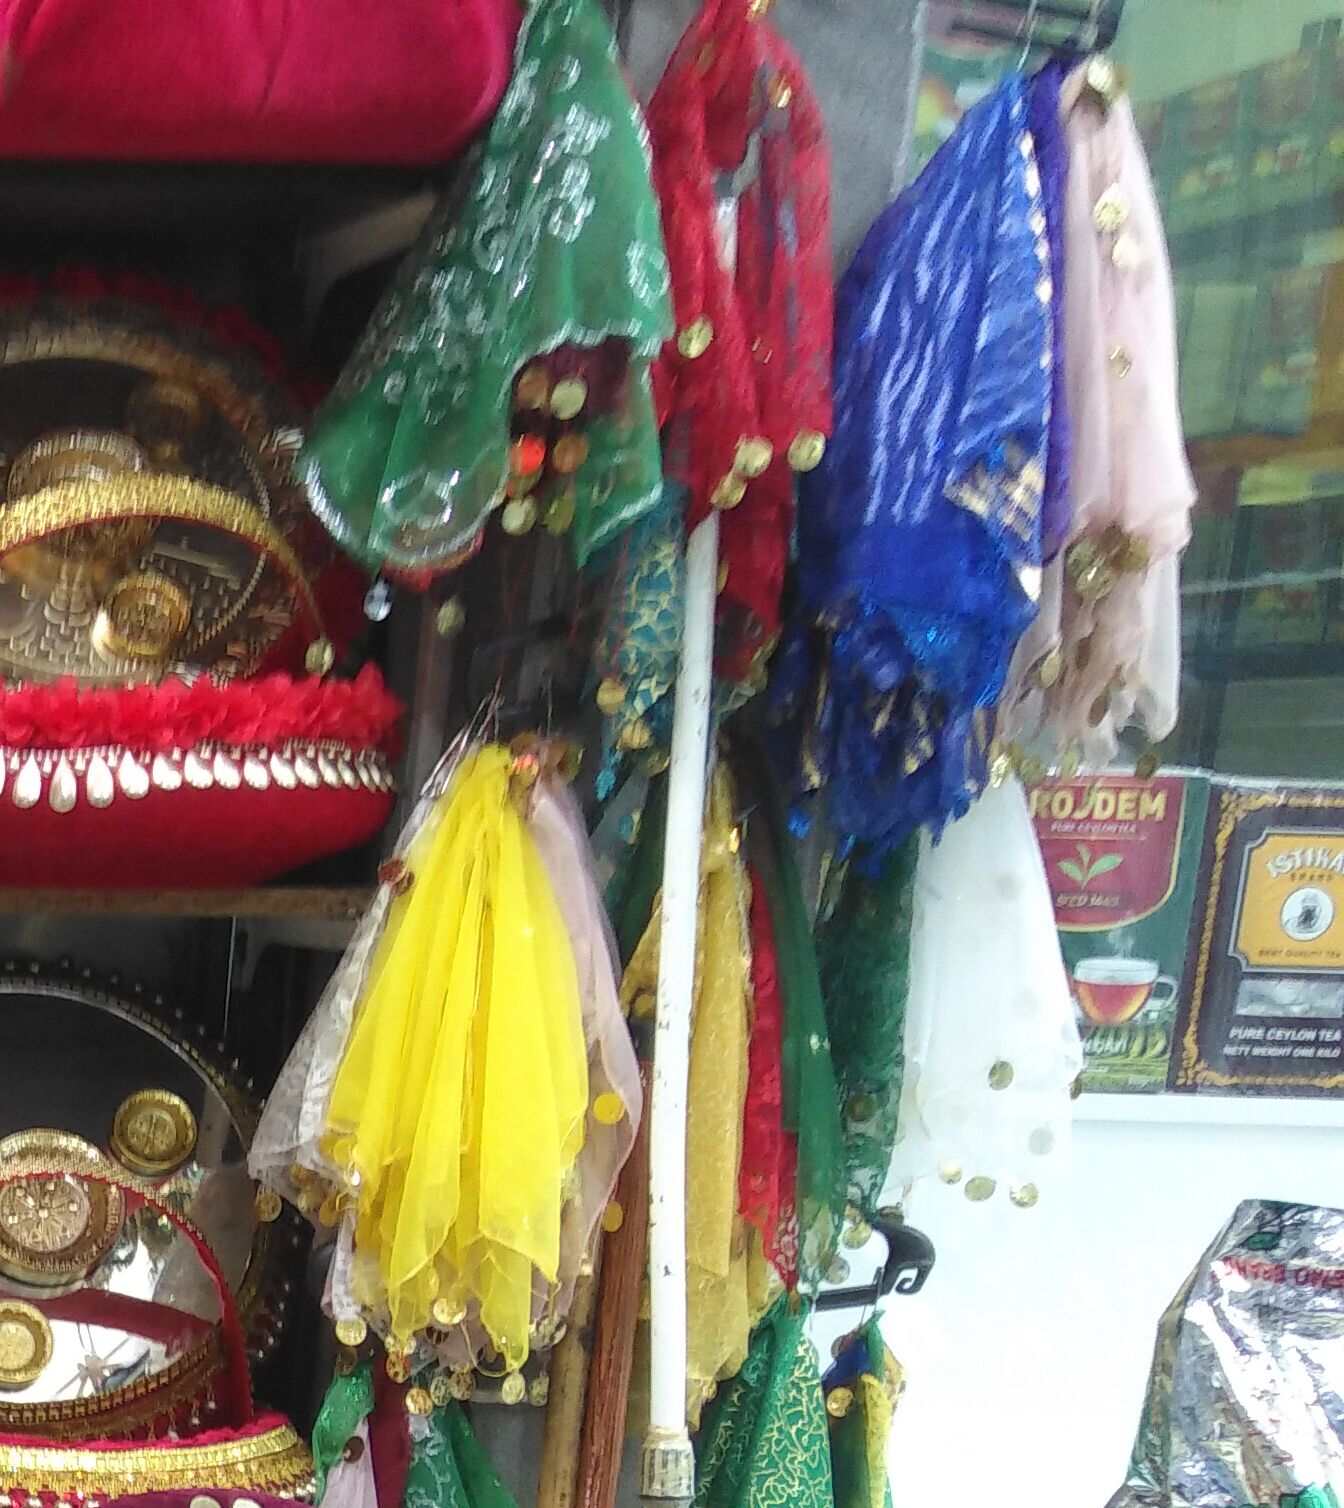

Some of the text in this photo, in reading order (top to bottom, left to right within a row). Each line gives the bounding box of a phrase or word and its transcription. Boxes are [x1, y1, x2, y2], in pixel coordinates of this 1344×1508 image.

[1229, 1026, 1343, 1042] PURE CEYLON TEA
